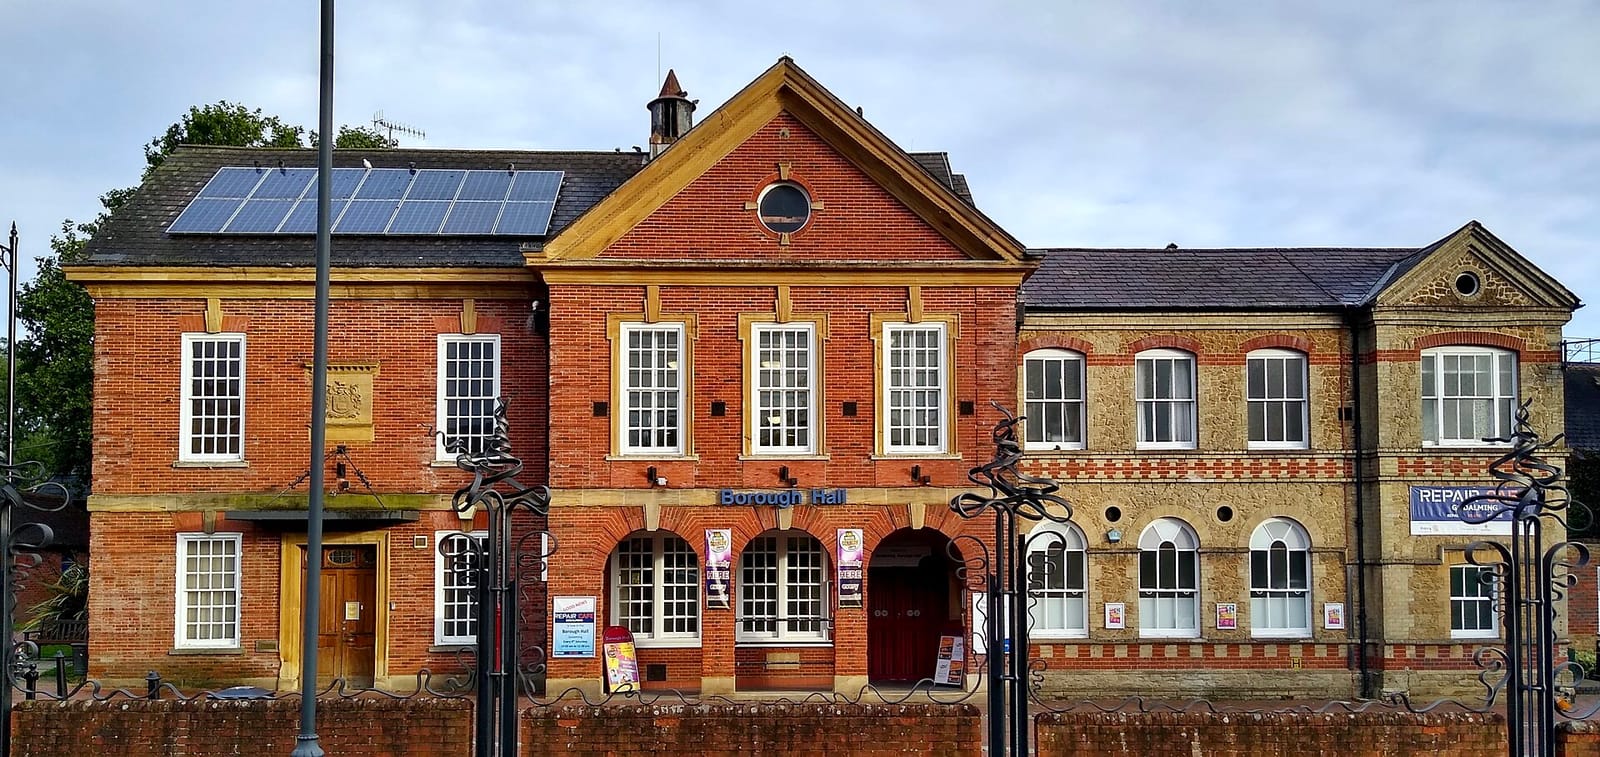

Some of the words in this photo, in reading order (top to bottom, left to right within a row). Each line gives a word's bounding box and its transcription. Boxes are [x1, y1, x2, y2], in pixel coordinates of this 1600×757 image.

[721, 488, 802, 508] Borough
[811, 487, 847, 505] Hall
[1420, 489, 1480, 503] REPAIR
[706, 570, 730, 580] HERE
[840, 570, 862, 579] HERE
